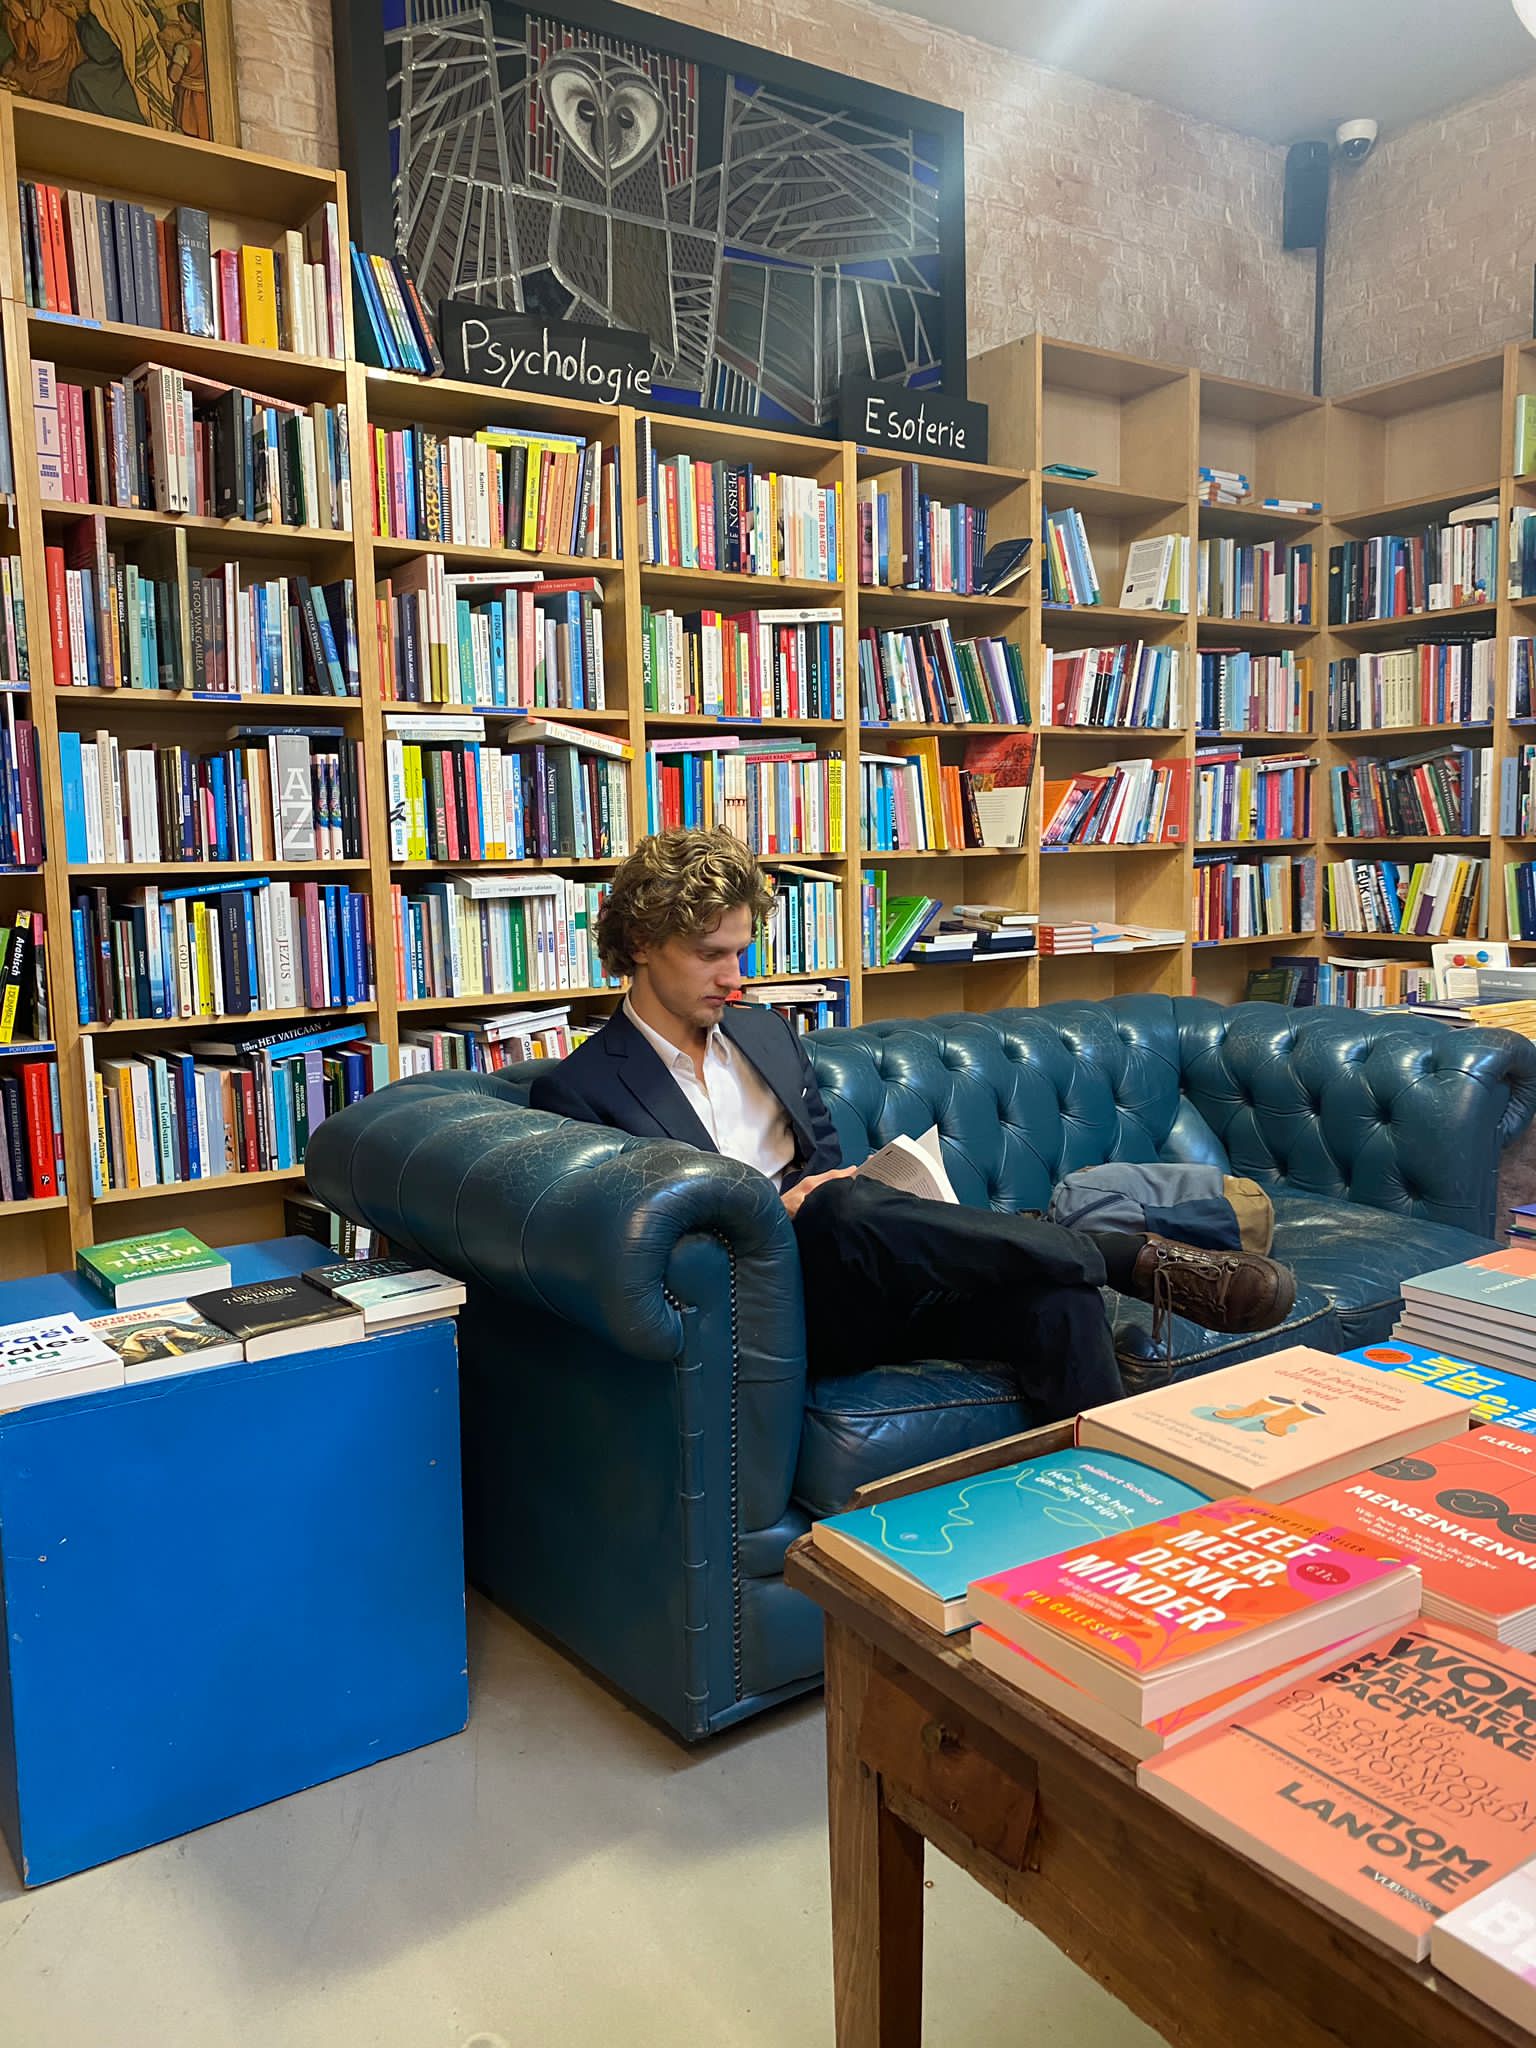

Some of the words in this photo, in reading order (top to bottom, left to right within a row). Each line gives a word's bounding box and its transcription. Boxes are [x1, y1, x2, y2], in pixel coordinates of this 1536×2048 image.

[256, 270, 264, 302] KORAN
[461, 319, 652, 406] Psychologie
[39, 377, 49, 399] BIJBEL
[864, 398, 966, 450] Esoterie
[728, 472, 739, 528] PERSON
[818, 500, 826, 523] BETER
[819, 541, 827, 559] ECHT
[118, 592, 124, 600] DE
[193, 580, 201, 592] DE
[193, 593, 201, 615] GOD
[193, 615, 202, 635] VAN
[194, 636, 204, 671] GALILEA
[281, 768, 311, 800] A
[548, 766, 556, 794] Asem
[281, 800, 314, 848] Z
[436, 807, 446, 845] KWIJT
[10, 936, 26, 976] Arabisch
[180, 944, 189, 970] GOD
[276, 938, 291, 979] JEZUS
[258, 1033, 277, 1046] HET
[277, 1023, 322, 1042] VATICAAN
[161, 1112, 170, 1158] Godsnaam
[105, 1246, 201, 1268] THEM
[120, 1242, 172, 1257] LET
[233, 1286, 297, 1303] OKTOBER
[1478, 1435, 1533, 1455] FLEUR
[1034, 1476, 1056, 1487] om
[1079, 1495, 1095, 1506] te
[1093, 1503, 1118, 1520] zijn
[1047, 1470, 1073, 1483] Hoe
[1098, 1491, 1111, 1502] is
[1109, 1499, 1135, 1515] het
[1163, 1529, 1290, 1588] MEER,
[1220, 1518, 1333, 1560] LEEF
[1057, 1554, 1227, 1632] MINDER
[1125, 1546, 1253, 1602] DENK
[1023, 1589, 1045, 1606] PIA
[1046, 1598, 1125, 1641] CALLESEN
[1357, 1652, 1442, 1687] HET
[1318, 1671, 1427, 1721] PACT
[1338, 1661, 1536, 1761] MARRAKE
[1274, 1696, 1349, 1731] ELKE
[1349, 1731, 1415, 1771] DAG
[1292, 1688, 1350, 1720] ONS
[1353, 1718, 1506, 1798] CAPITOOL
[1395, 1722, 1465, 1764] HOE
[1300, 1723, 1474, 1818] BESTORMD)
[1305, 1746, 1344, 1767] een
[1276, 1781, 1472, 1894] LANOYE
[1384, 1814, 1492, 1877] TOM
